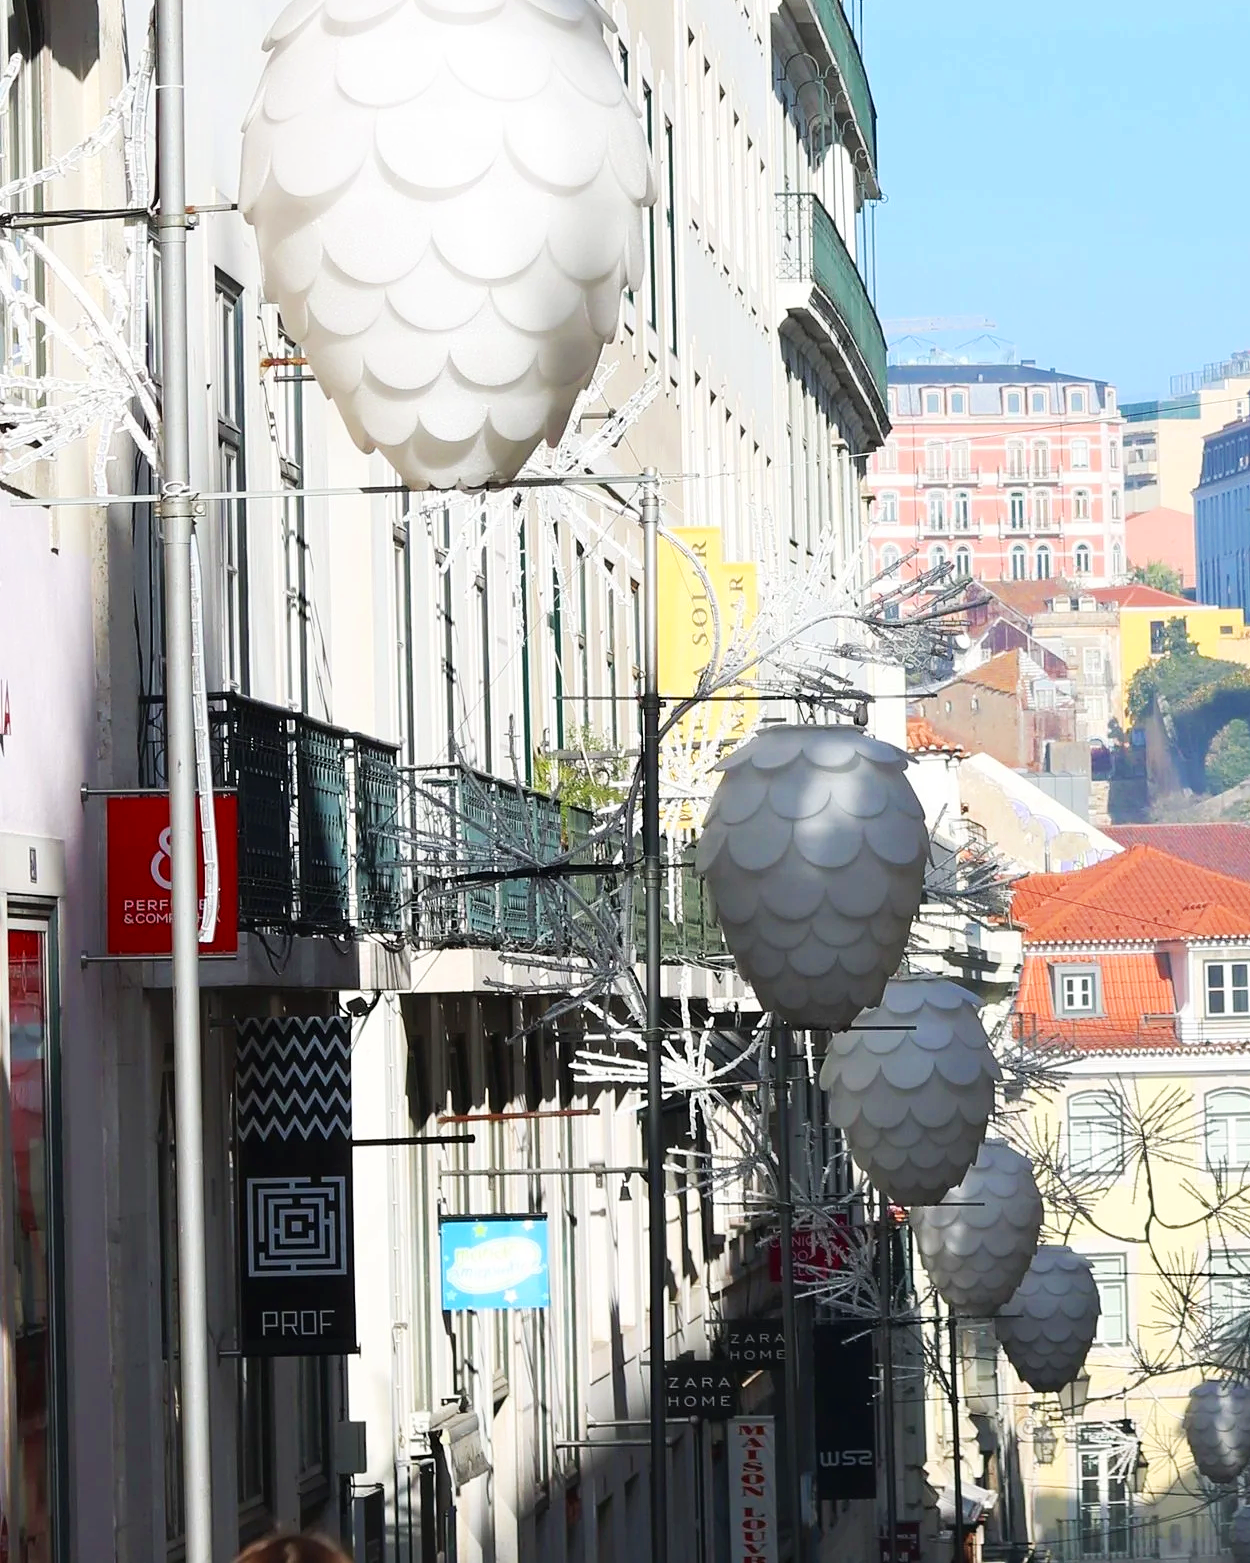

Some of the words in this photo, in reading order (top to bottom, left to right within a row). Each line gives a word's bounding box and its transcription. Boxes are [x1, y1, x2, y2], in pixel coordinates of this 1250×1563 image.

[262, 1309, 336, 1336] PROF
[729, 1333, 785, 1345] ZARA
[729, 1349, 786, 1361] HOME
[668, 1376, 732, 1389] ZARA
[668, 1395, 732, 1408] HOME
[738, 1424, 766, 1498] MAISON
